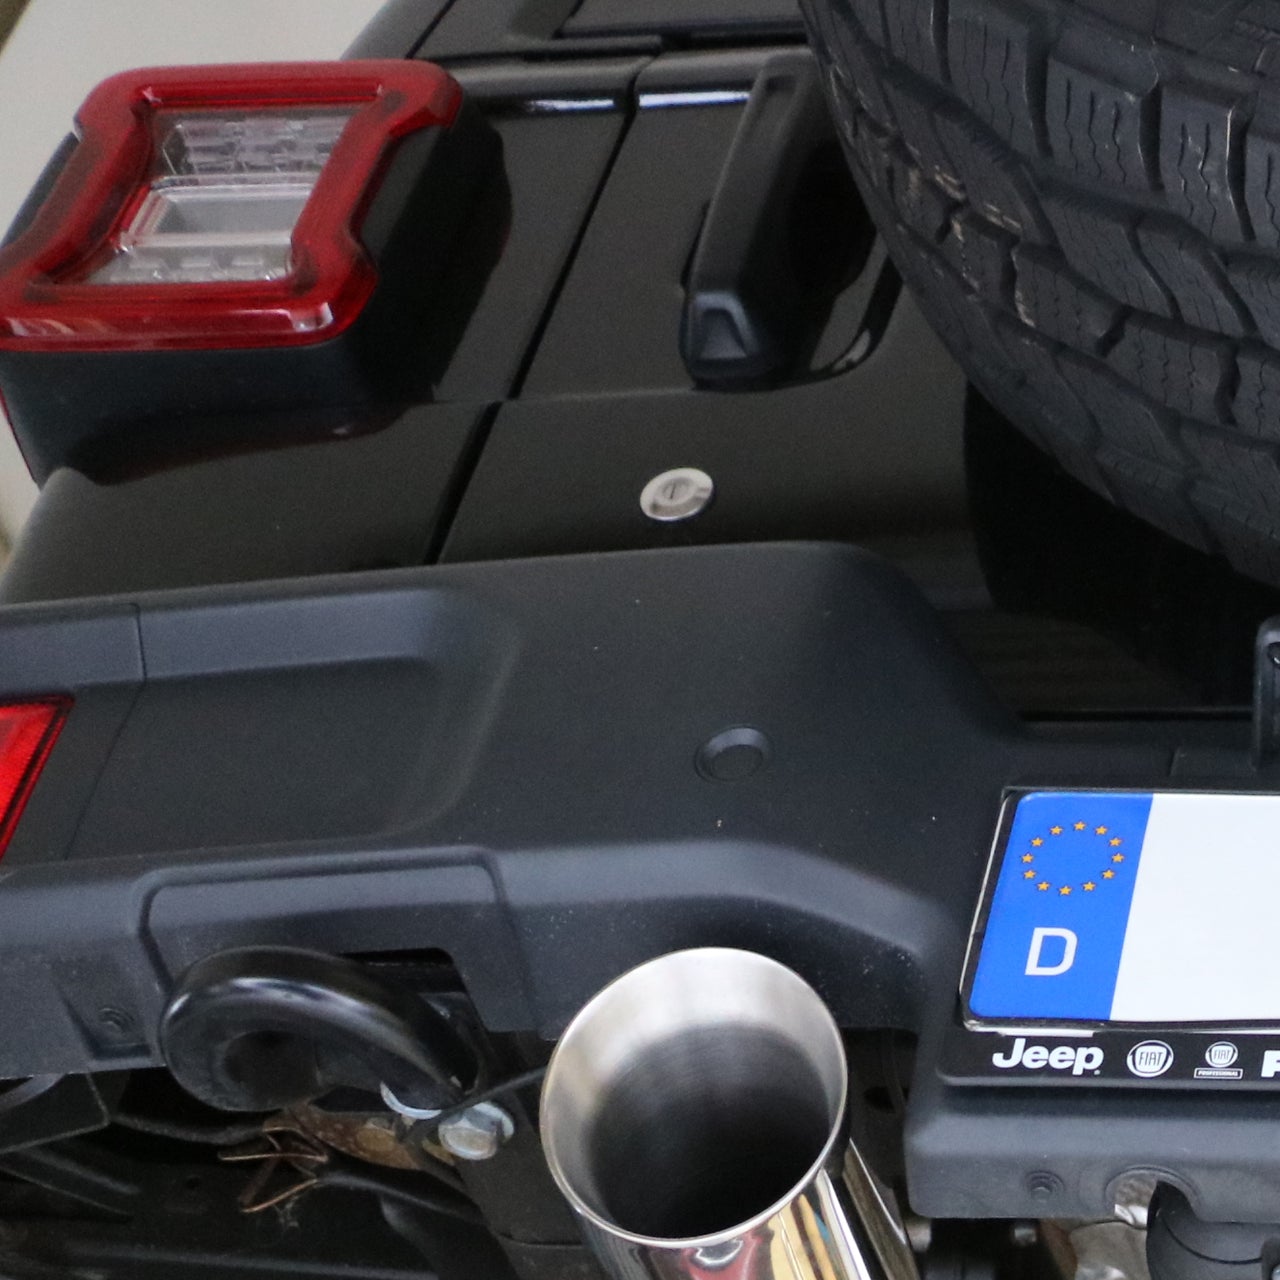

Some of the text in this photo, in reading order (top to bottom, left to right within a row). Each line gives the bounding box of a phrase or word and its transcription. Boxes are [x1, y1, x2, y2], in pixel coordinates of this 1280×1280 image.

[1023, 926, 1079, 977] D
[992, 1036, 1105, 1076] Jeep
[1138, 1050, 1164, 1067] FIAT
